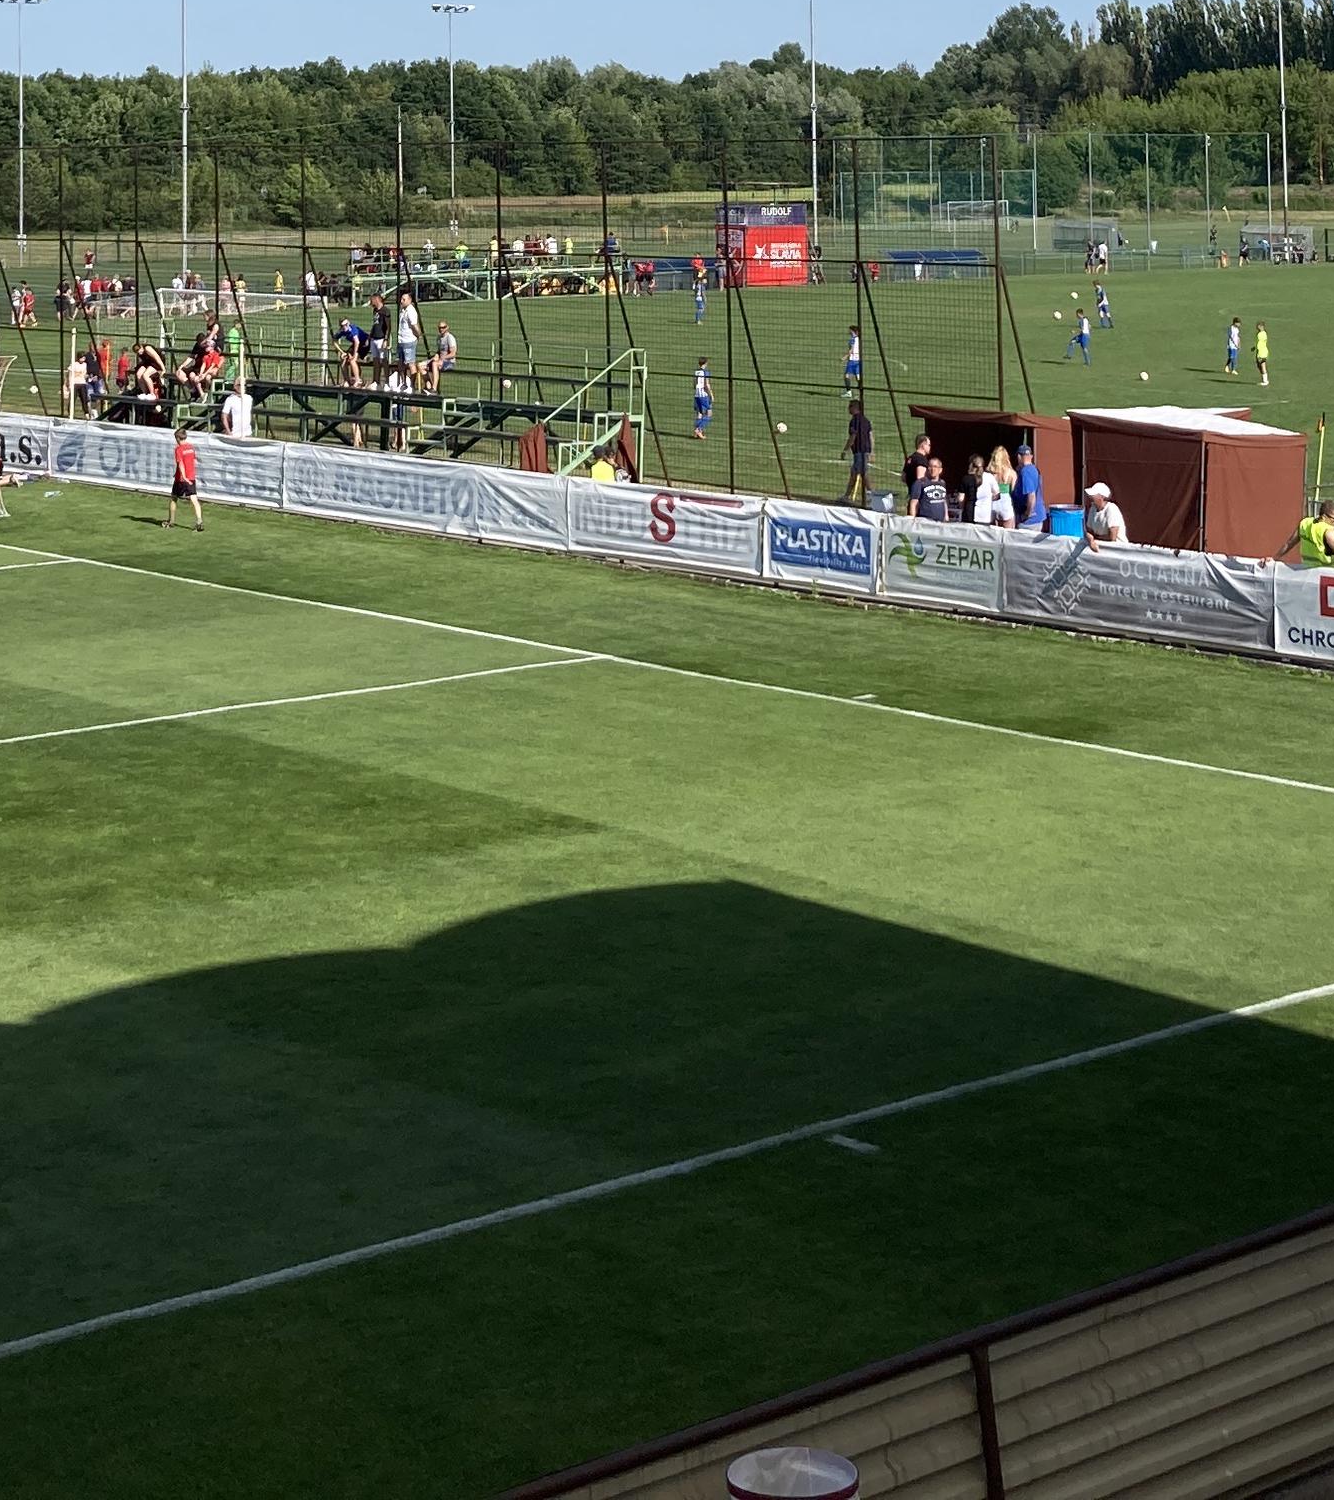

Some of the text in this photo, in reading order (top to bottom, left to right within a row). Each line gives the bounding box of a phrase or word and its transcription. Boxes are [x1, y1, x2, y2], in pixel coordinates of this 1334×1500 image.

[775, 526, 866, 558] PLASTIKA
[935, 544, 995, 571] ZEPAR
[1099, 580, 1136, 598] hotel
[1152, 591, 1230, 611] restaurant
